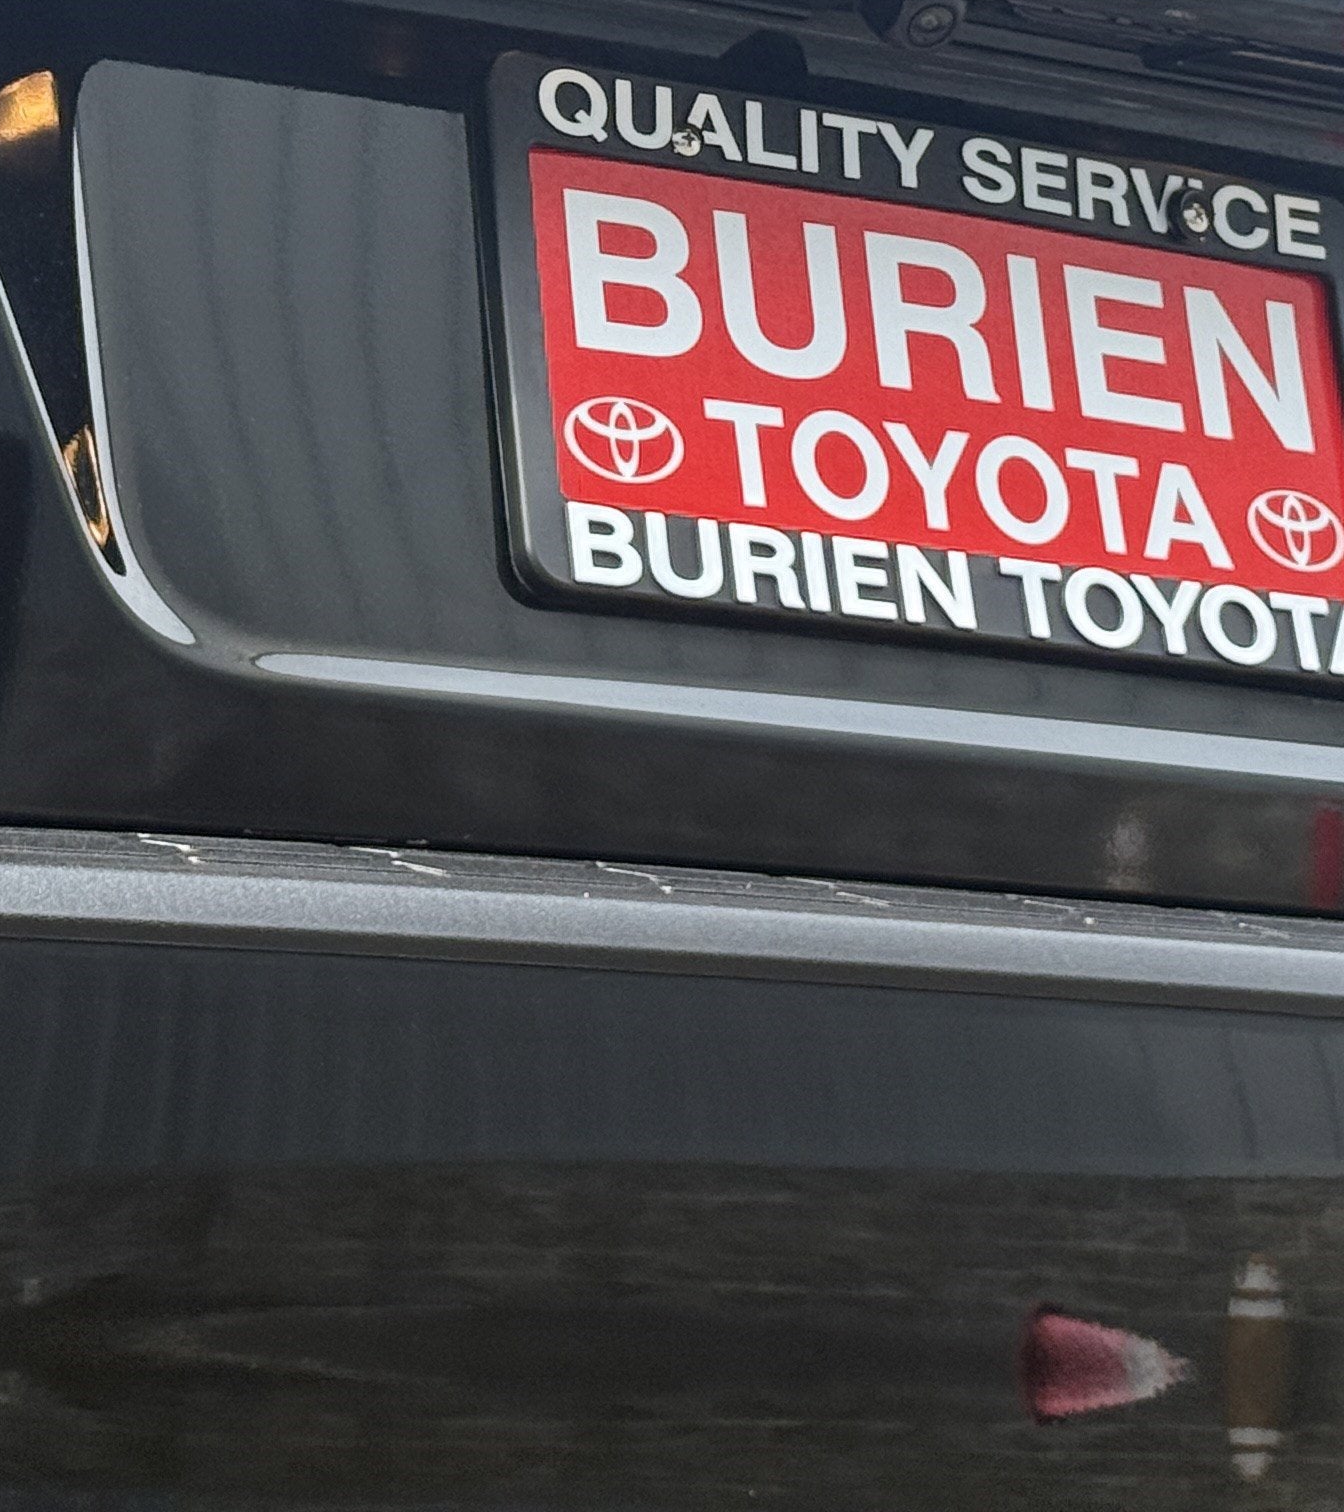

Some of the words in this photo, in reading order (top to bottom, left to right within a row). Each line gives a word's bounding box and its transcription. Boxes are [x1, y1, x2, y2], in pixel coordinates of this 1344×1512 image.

[538, 68, 934, 190] QUALITY
[962, 137, 1327, 261] SERVCE
[562, 188, 1316, 454] BURIEN
[565, 500, 978, 632] BURIEN
[703, 398, 1236, 571] TOYOTA
